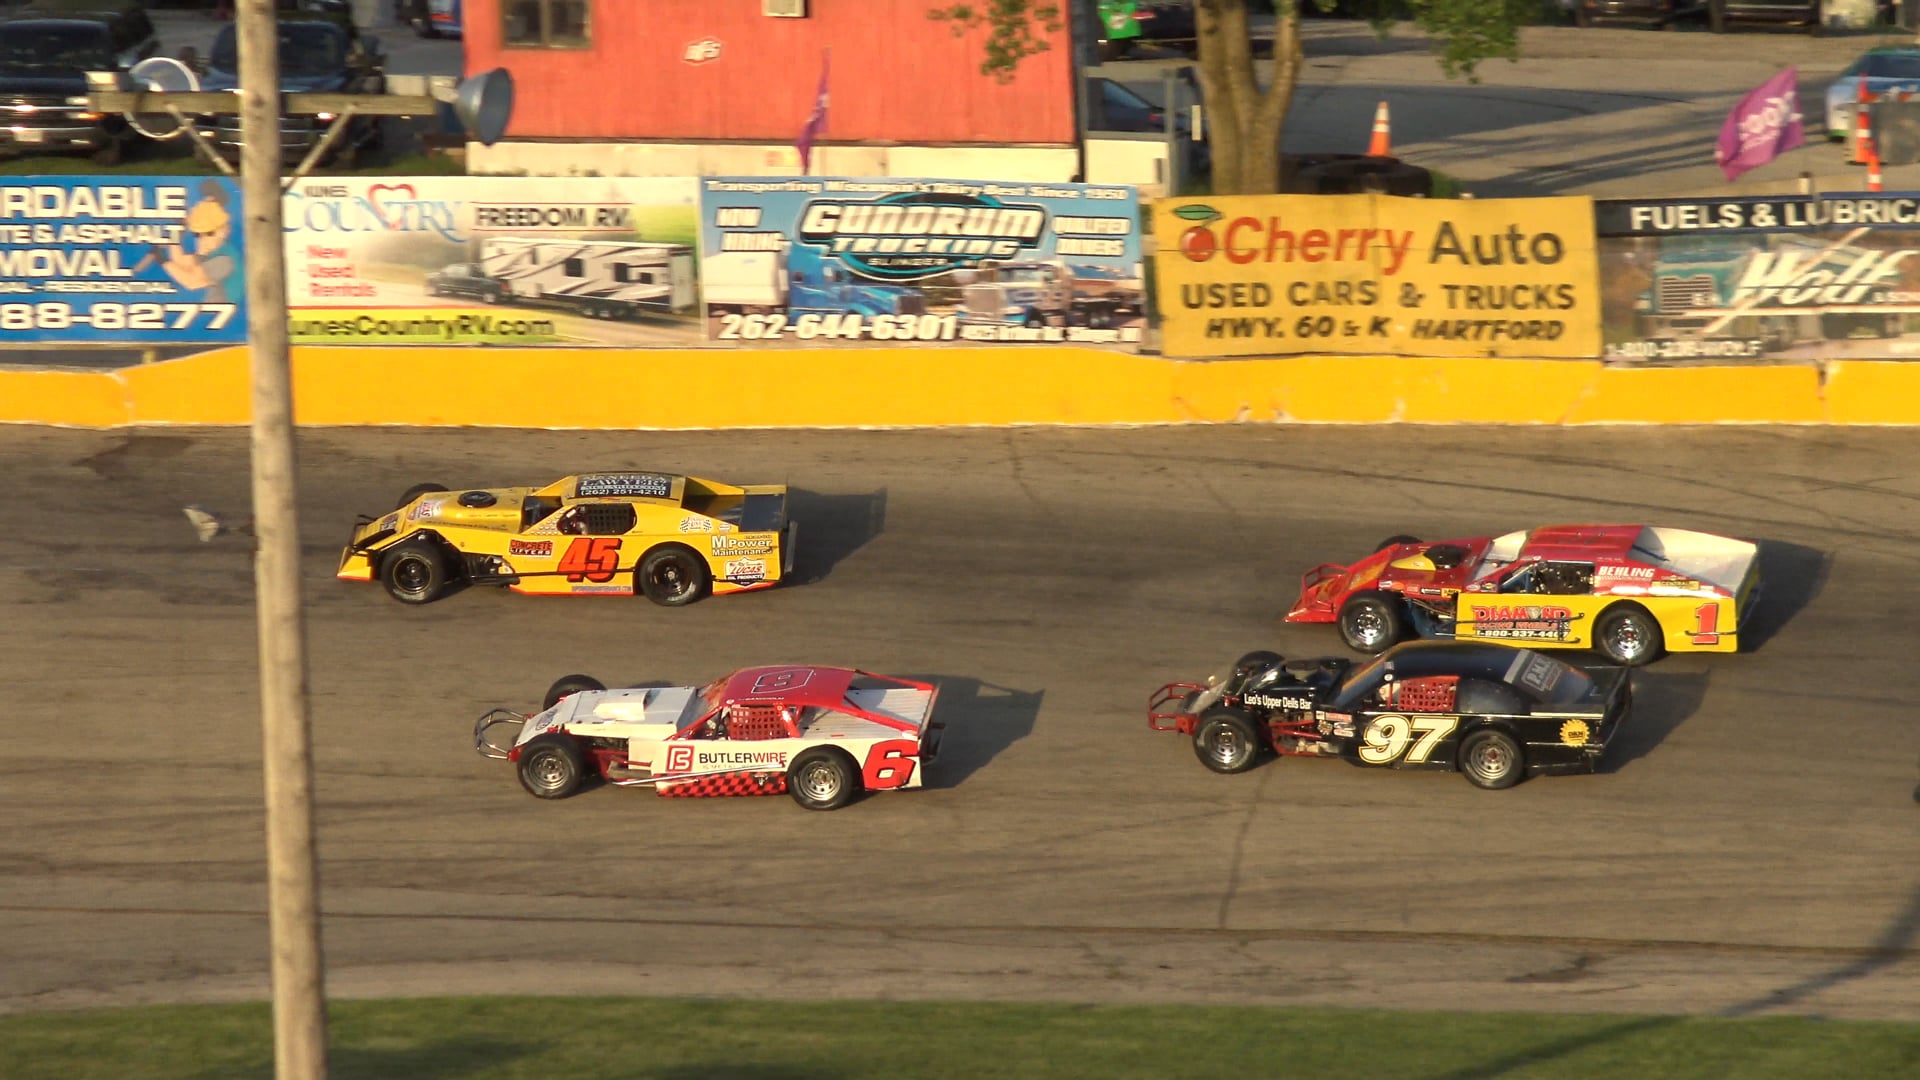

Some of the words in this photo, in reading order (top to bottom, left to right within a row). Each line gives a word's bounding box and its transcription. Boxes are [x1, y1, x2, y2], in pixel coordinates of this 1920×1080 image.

[475, 207, 586, 227] FREEDOM
[803, 204, 1042, 237] GUNDRUM
[1630, 204, 1744, 230] FUELS
[1751, 202, 1776, 228] &
[1784, 198, 1920, 226] LUBRIC
[57, 225, 184, 243] ASPHALT
[1224, 216, 1413, 275] Cherry
[1429, 220, 1565, 265] Auto
[306, 245, 346, 259] New
[832, 237, 1018, 256] TRUCKING
[307, 264, 354, 279] Used
[309, 283, 377, 297] Rentals
[1181, 283, 1272, 309] USED
[1288, 281, 1378, 307] CARS
[1399, 283, 1425, 307] &
[1441, 283, 1576, 309] TRUCKS
[0, 302, 236, 329] 88-8277
[288, 315, 554, 338] unesCountryRV.com
[719, 314, 957, 340] 262-644-6301
[1205, 316, 1284, 338] HWY.
[1294, 316, 1334, 338] 60
[1369, 316, 1391, 337] K
[1411, 320, 1566, 340] HARTFORD
[558, 538, 622, 582] 45
[730, 566, 762, 574] LUCAS
[1599, 566, 1655, 577] BEHLING
[1693, 603, 1719, 644] 1
[1244, 693, 1261, 705] Leo's
[1262, 694, 1281, 708] Upper
[1300, 699, 1312, 709] Bar
[1359, 714, 1459, 764] 97
[862, 739, 919, 790] 6
